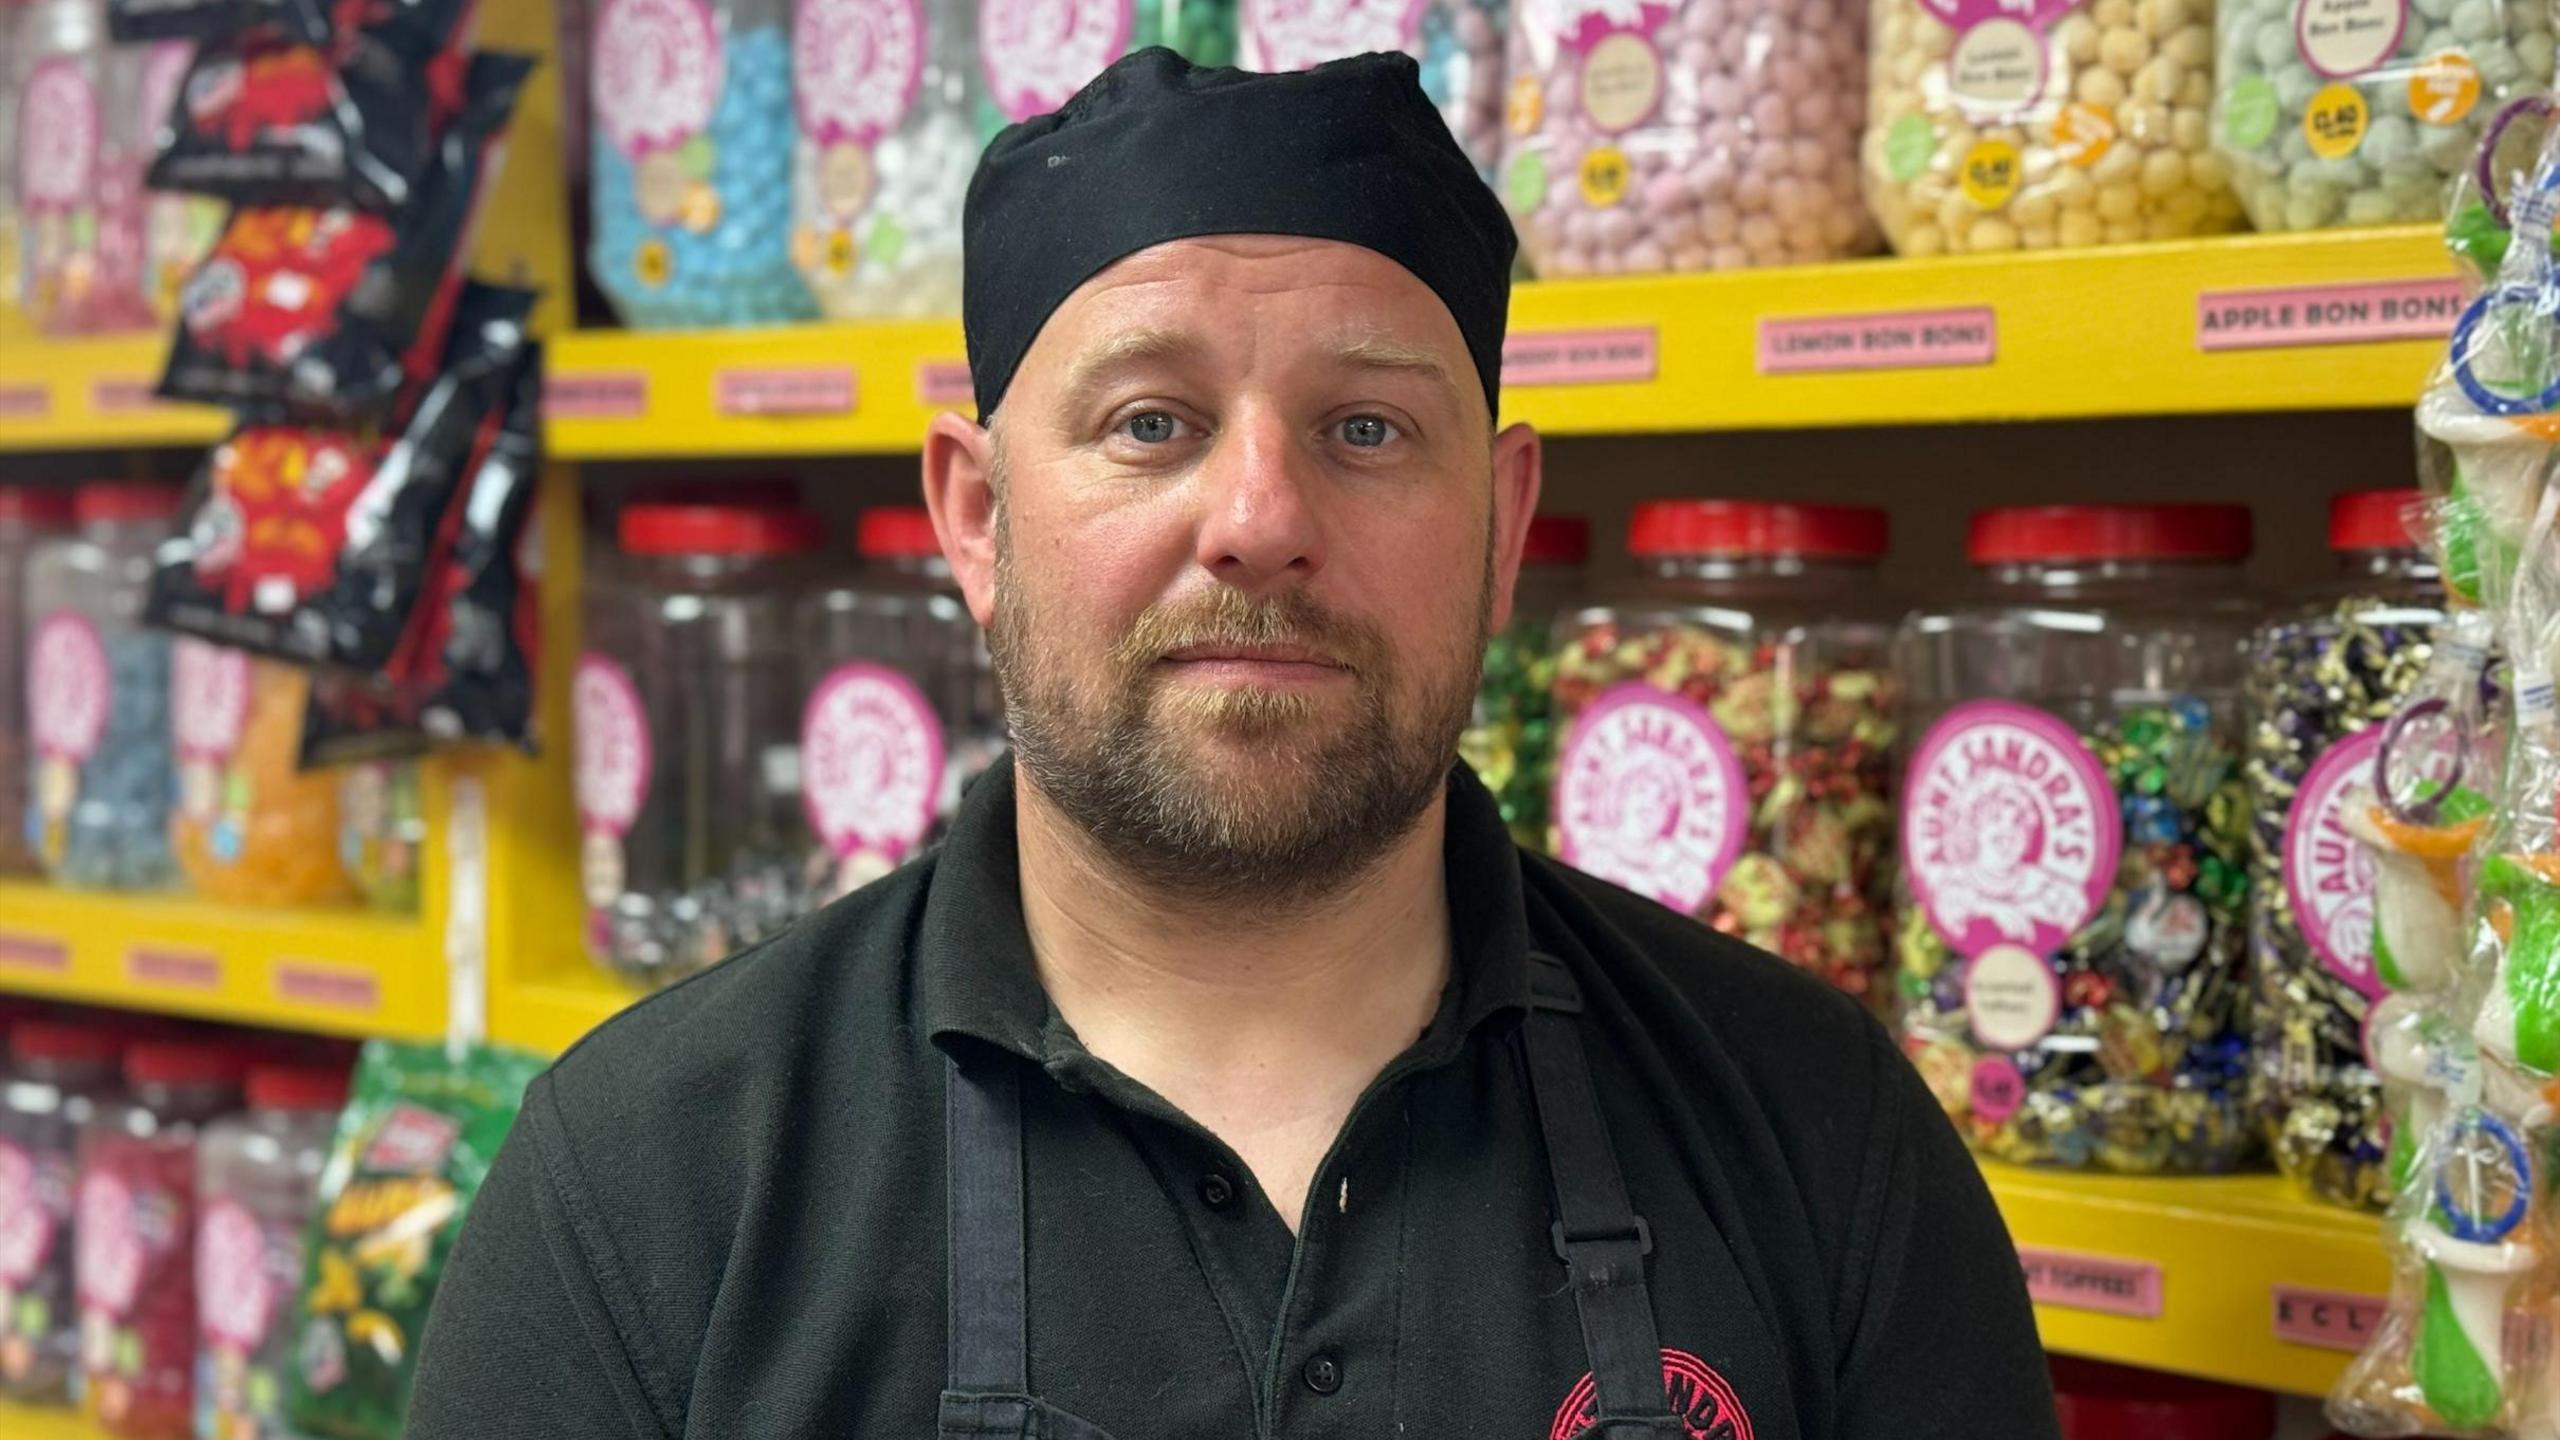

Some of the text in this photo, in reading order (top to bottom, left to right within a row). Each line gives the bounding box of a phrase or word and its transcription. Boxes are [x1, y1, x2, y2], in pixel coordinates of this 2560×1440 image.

[2204, 294, 2461, 330] APPLE BON BONS
[1774, 325, 1985, 353] LEMON BON BONS
[1925, 736, 2086, 864] AUNT SANDRA'S
